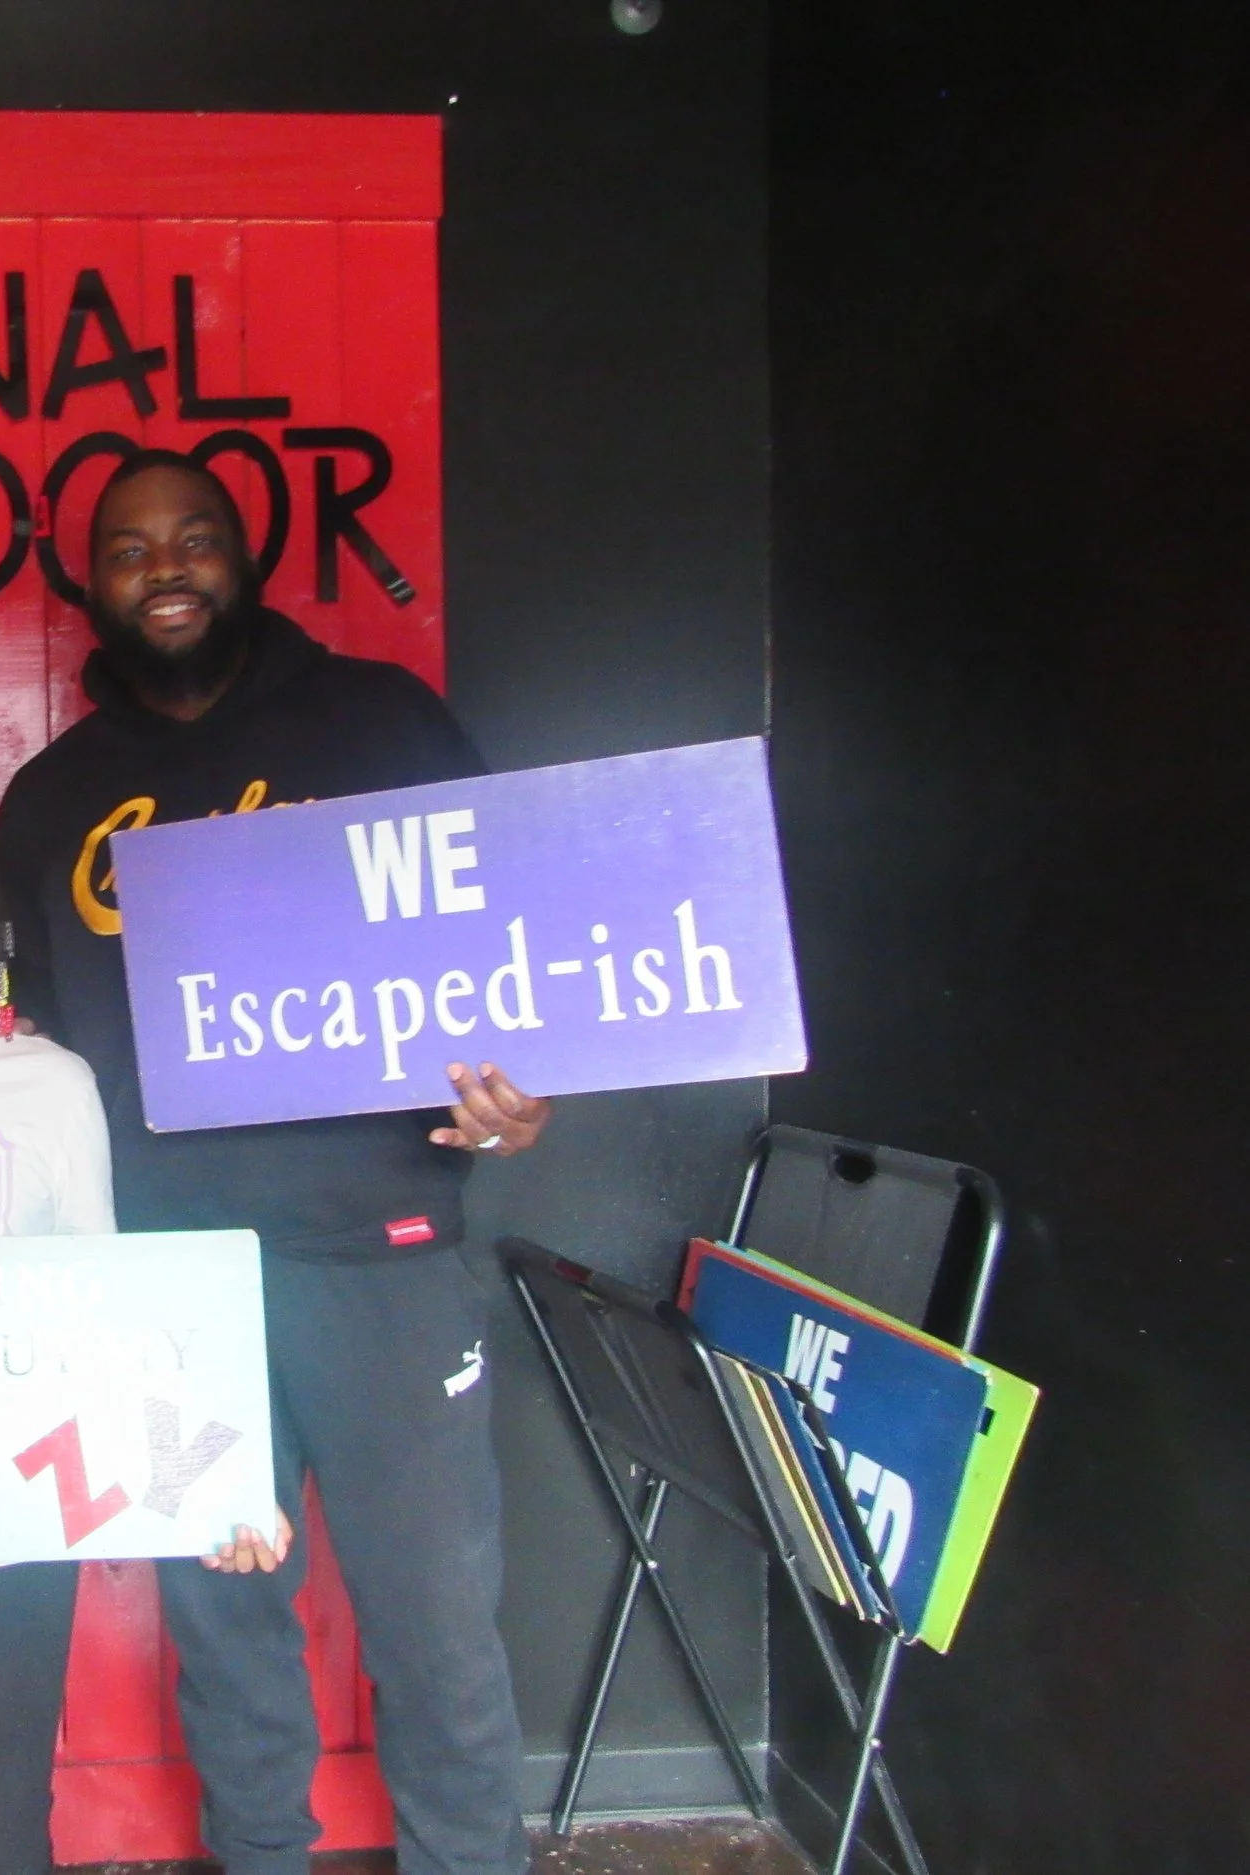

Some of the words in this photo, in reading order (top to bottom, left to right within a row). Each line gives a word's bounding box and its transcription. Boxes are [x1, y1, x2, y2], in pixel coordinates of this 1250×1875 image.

[345, 809, 486, 922] WE
[177, 899, 743, 1081] Escaped-ish
[785, 1314, 850, 1413] WE
[828, 1437, 912, 1587] ED
